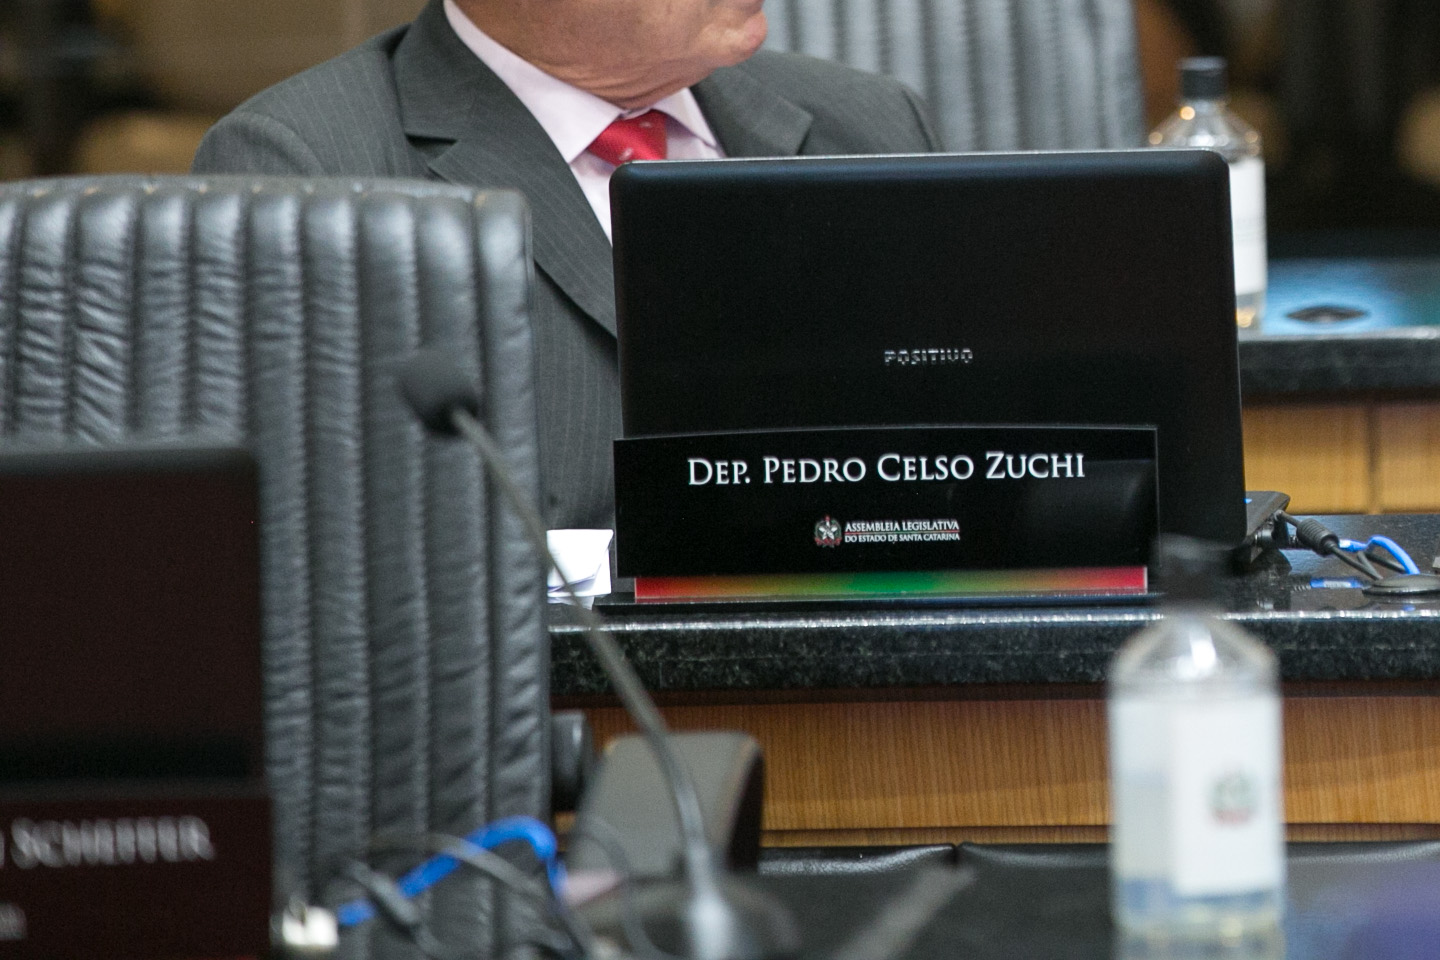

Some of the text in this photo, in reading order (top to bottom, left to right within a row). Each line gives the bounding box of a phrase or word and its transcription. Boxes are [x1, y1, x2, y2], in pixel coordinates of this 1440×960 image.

[884, 348, 974, 365] POSITIVO
[687, 451, 1085, 486] DEP. PEDRO CELSO ZUCHI
[845, 520, 960, 532] ASSEMBLEIA LEGISLATIVA
[844, 531, 960, 543] DO ESTADO DE SANTA CATARINA
